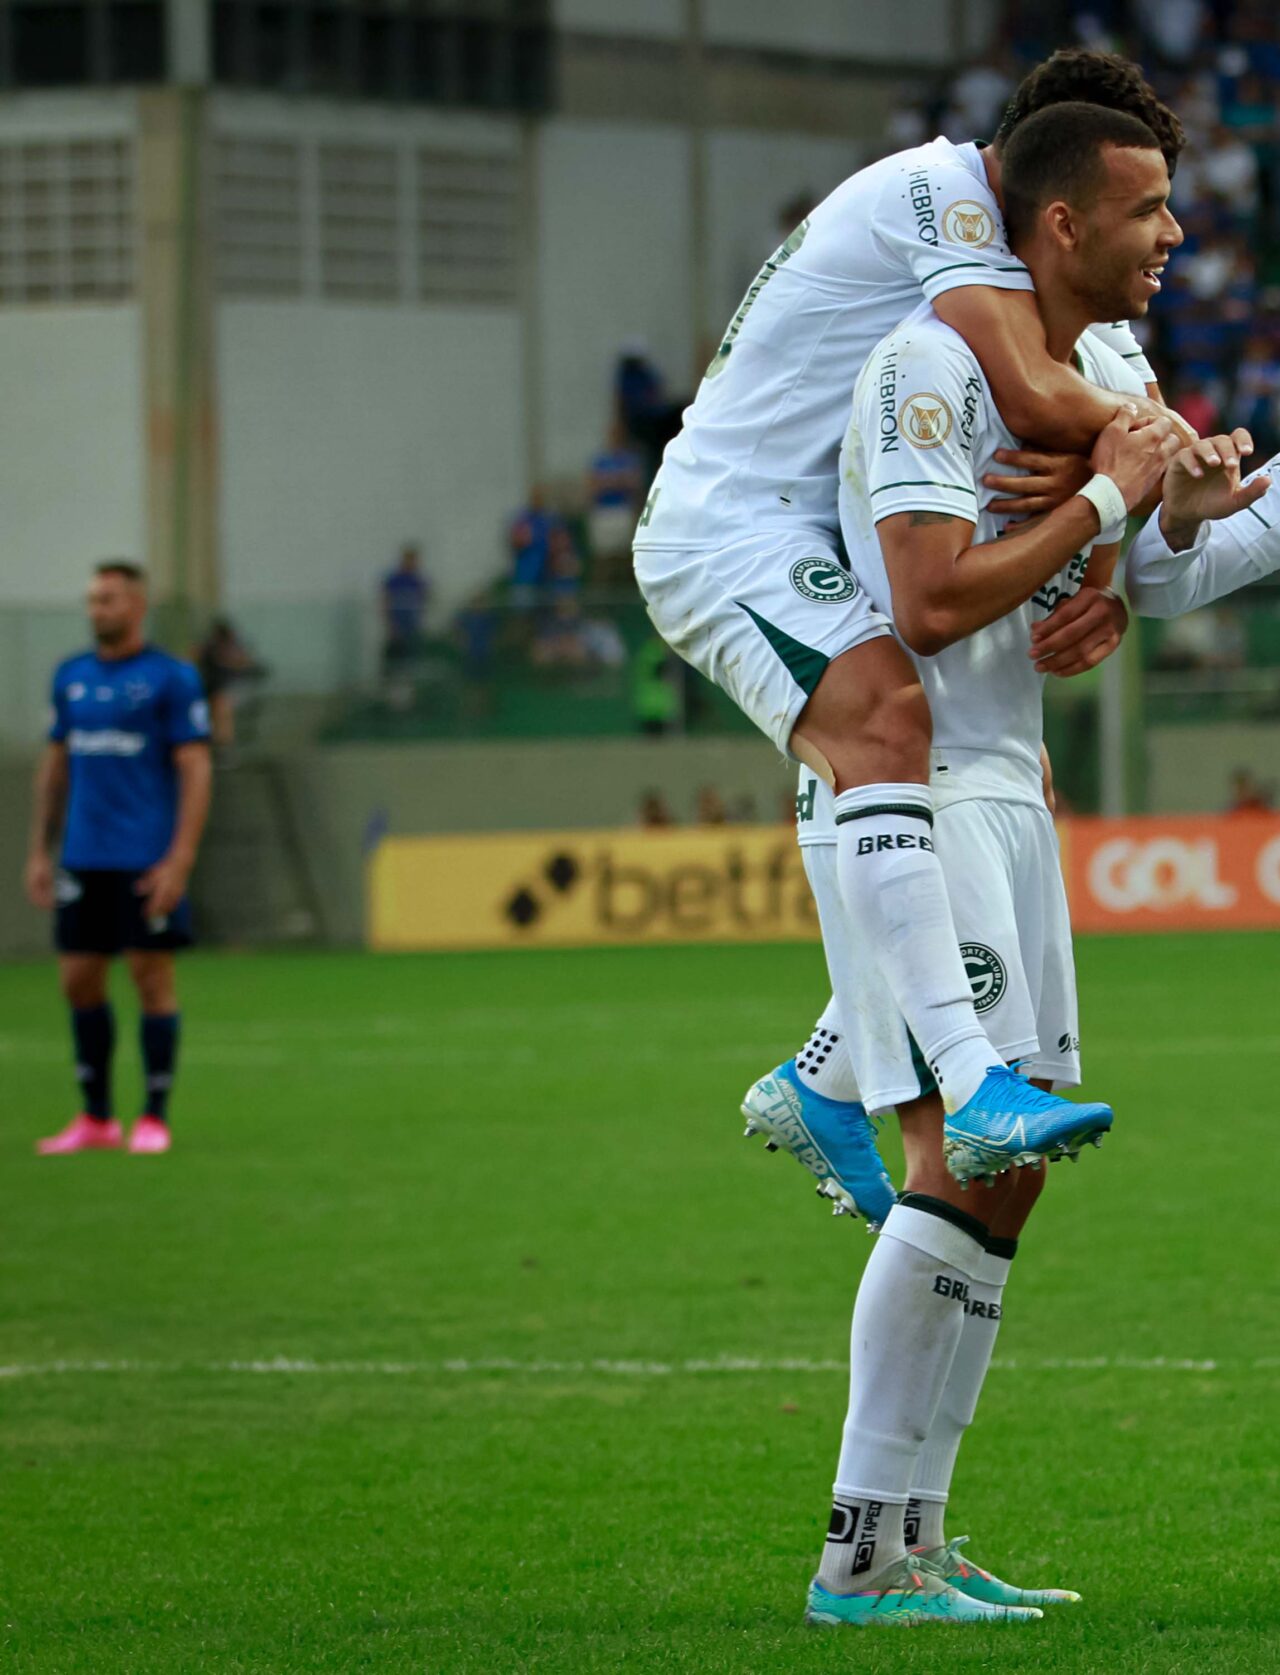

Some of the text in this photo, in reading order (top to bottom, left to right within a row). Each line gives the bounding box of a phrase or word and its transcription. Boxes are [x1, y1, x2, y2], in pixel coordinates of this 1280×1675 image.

[879, 352, 899, 454] HEBRON
[856, 833, 936, 857] GREE
[1090, 836, 1240, 912] GOL
